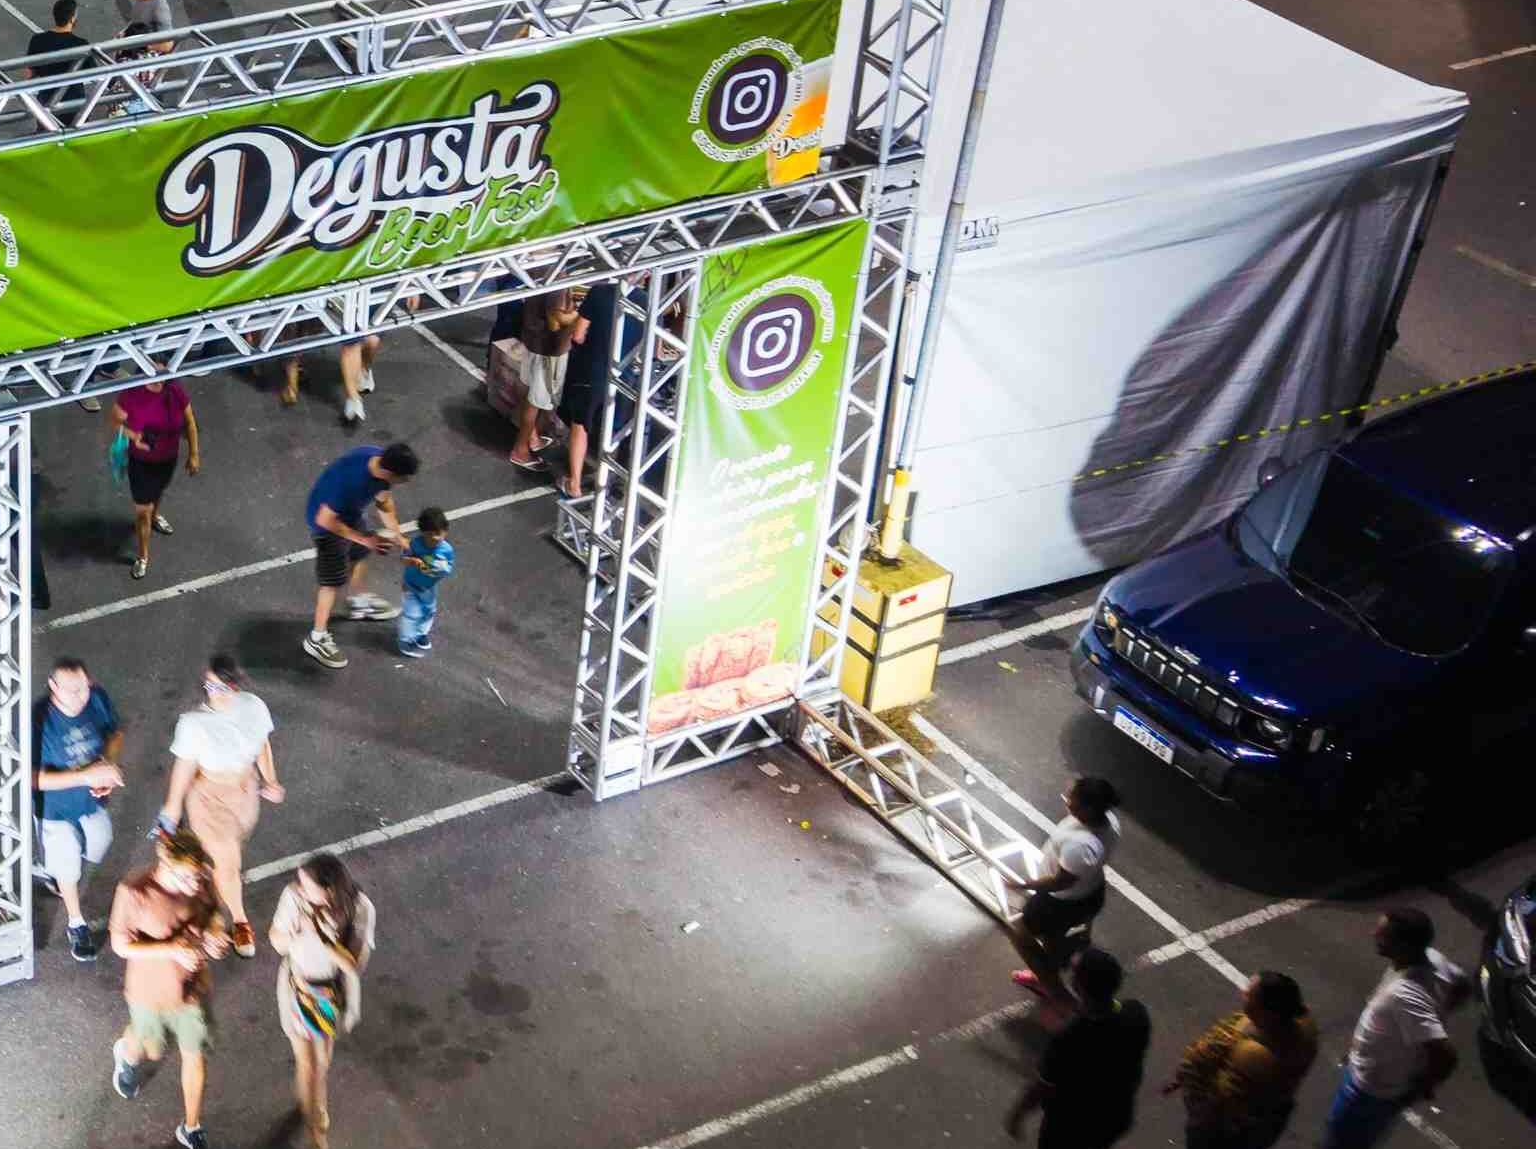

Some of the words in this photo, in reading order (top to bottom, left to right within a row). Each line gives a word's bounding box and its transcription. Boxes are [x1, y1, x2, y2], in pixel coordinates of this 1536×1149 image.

[161, 82, 556, 272] Degusta
[367, 199, 476, 268] Beer
[468, 169, 560, 238] Fest
